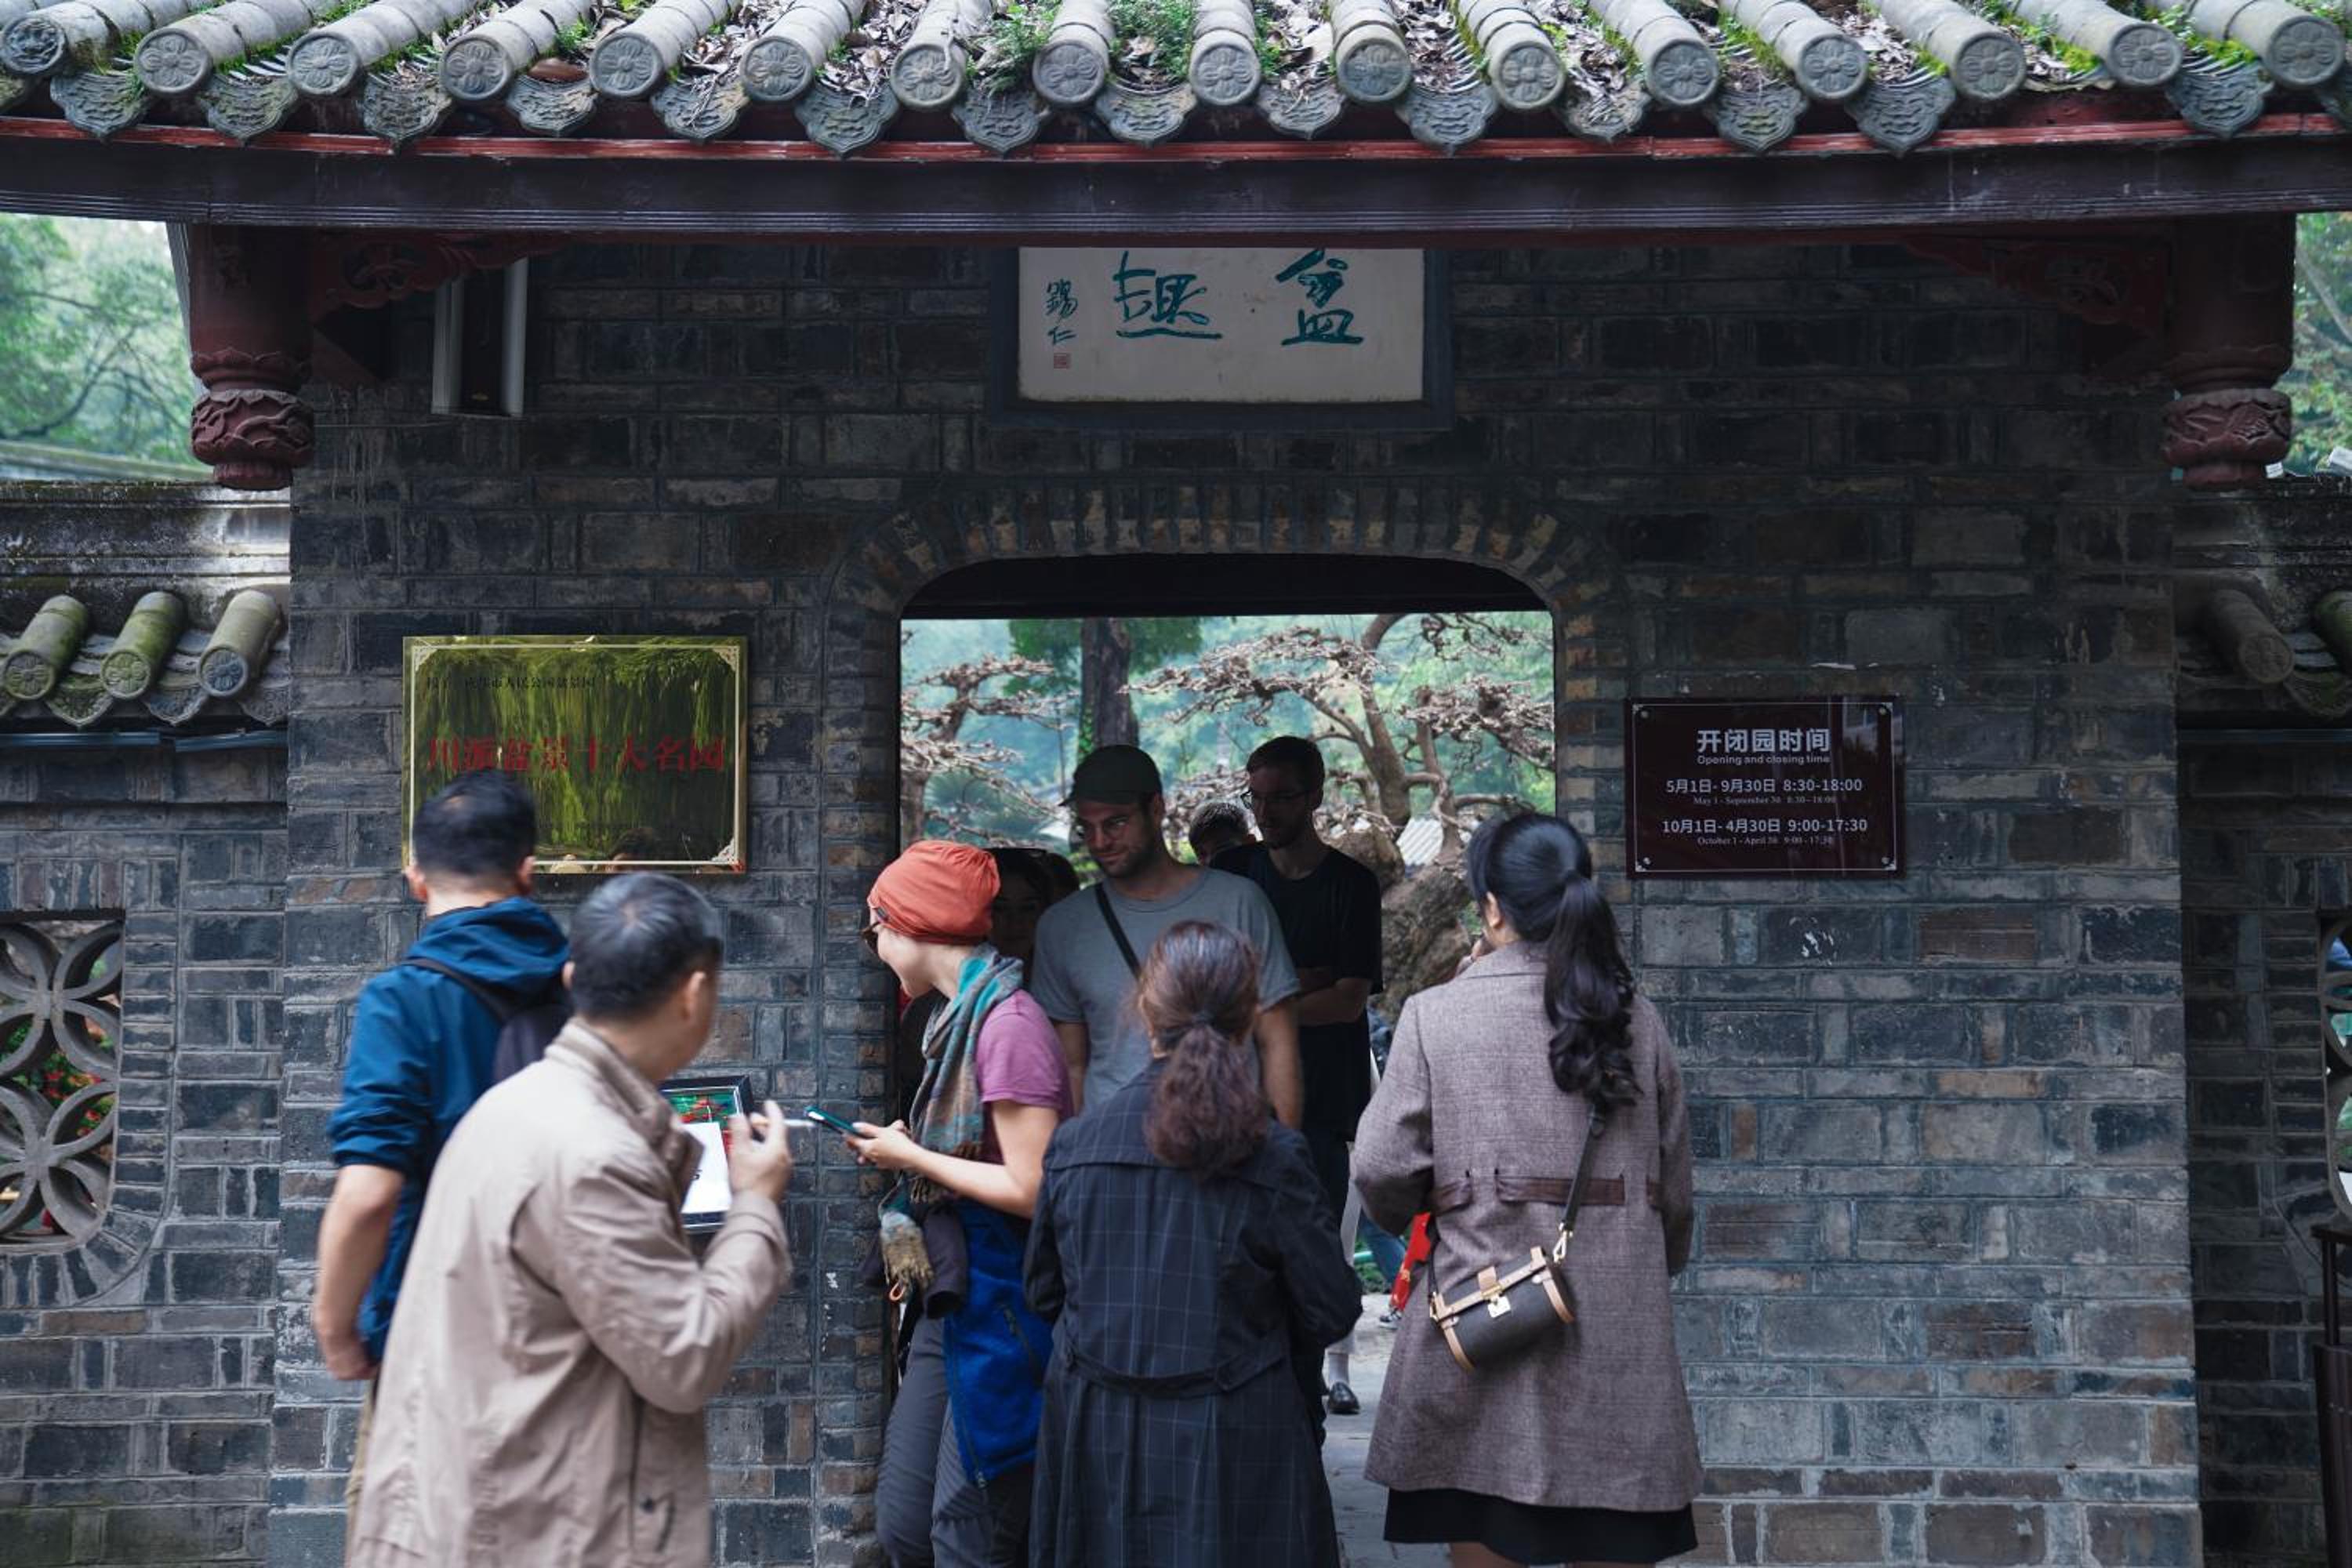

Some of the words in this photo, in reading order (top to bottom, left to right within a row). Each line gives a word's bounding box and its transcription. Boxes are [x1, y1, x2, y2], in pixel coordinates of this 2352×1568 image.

[1697, 729, 1830, 753] 开闭园时间
[1697, 755, 1741, 765] Opening
[1744, 755, 1764, 764] and
[1766, 755, 1804, 765] closing
[1784, 779, 1862, 792] 8:30-18:00
[1693, 797, 1711, 806] May
[1726, 797, 1769, 806] September
[1788, 819, 1867, 832] 9:00-17:30
[1697, 837, 1730, 845] October
[1744, 837, 1765, 846] April
